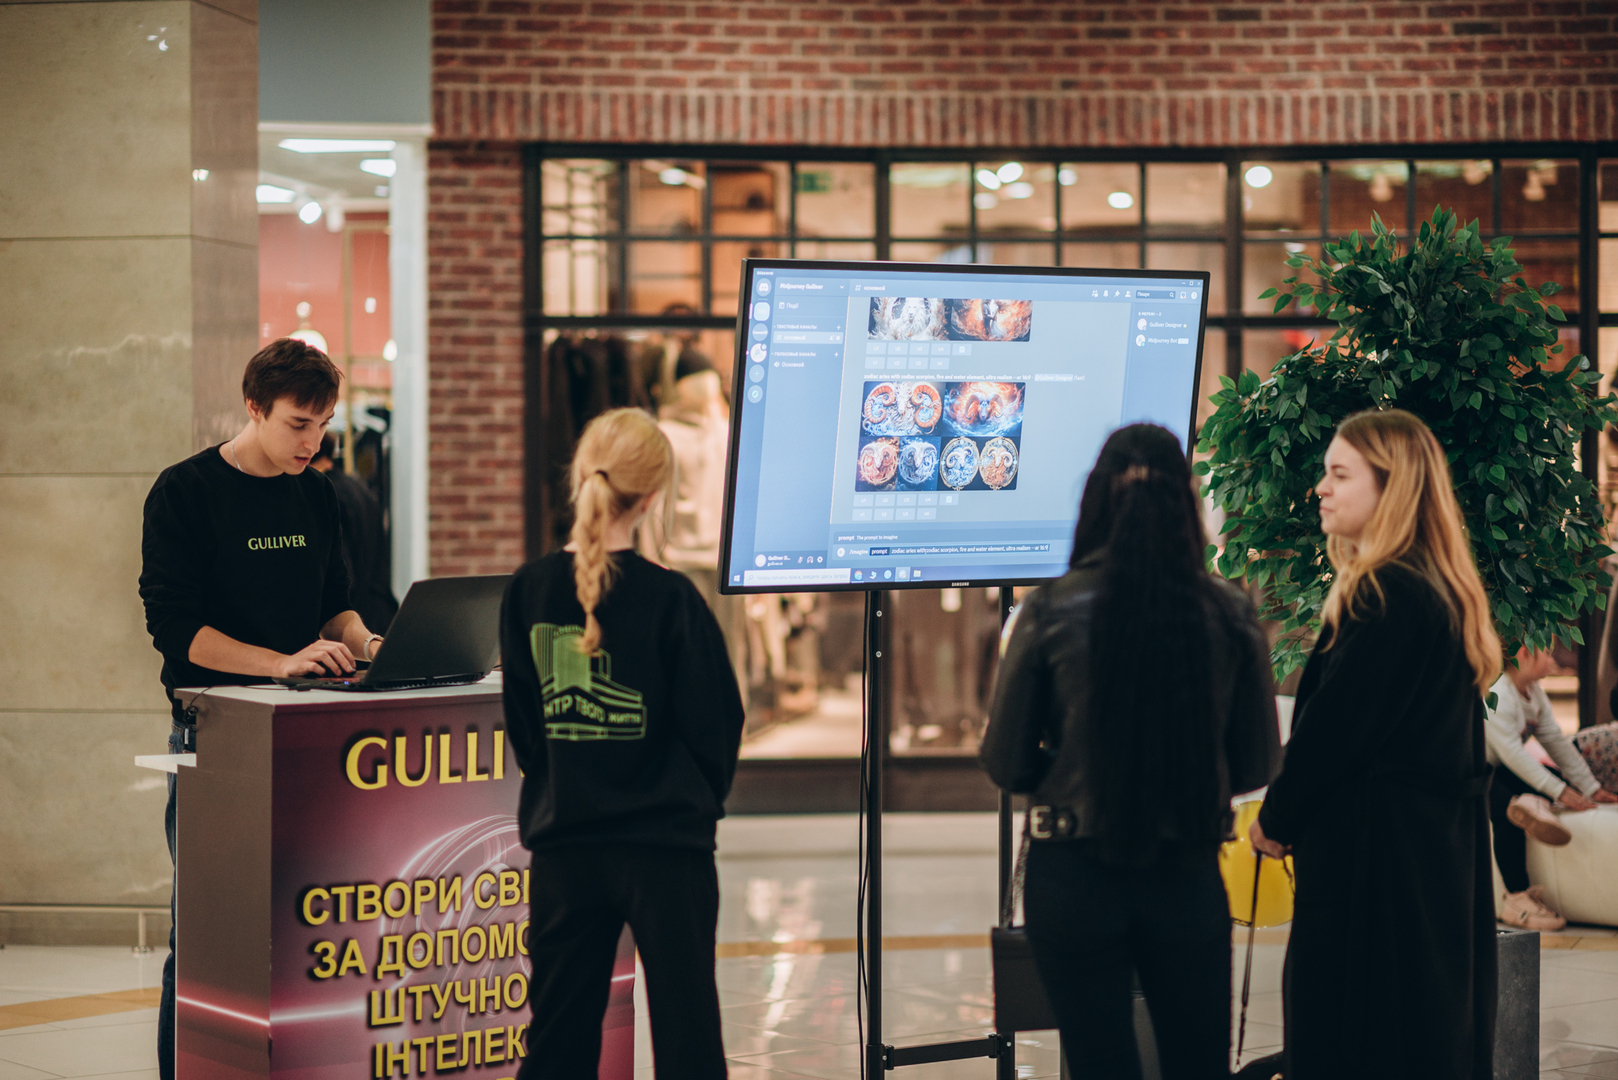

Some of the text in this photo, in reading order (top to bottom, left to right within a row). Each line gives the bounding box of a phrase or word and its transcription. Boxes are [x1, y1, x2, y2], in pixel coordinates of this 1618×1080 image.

[247, 534, 306, 550] GULLIVER
[346, 730, 525, 790] GULLI
[303, 869, 530, 926] СТВОРИ СВІ
[313, 920, 530, 980] ЗА ДОПОМО
[371, 973, 528, 1026] ШТУЧНО
[376, 1023, 529, 1078] ІНТЕЛЕК
